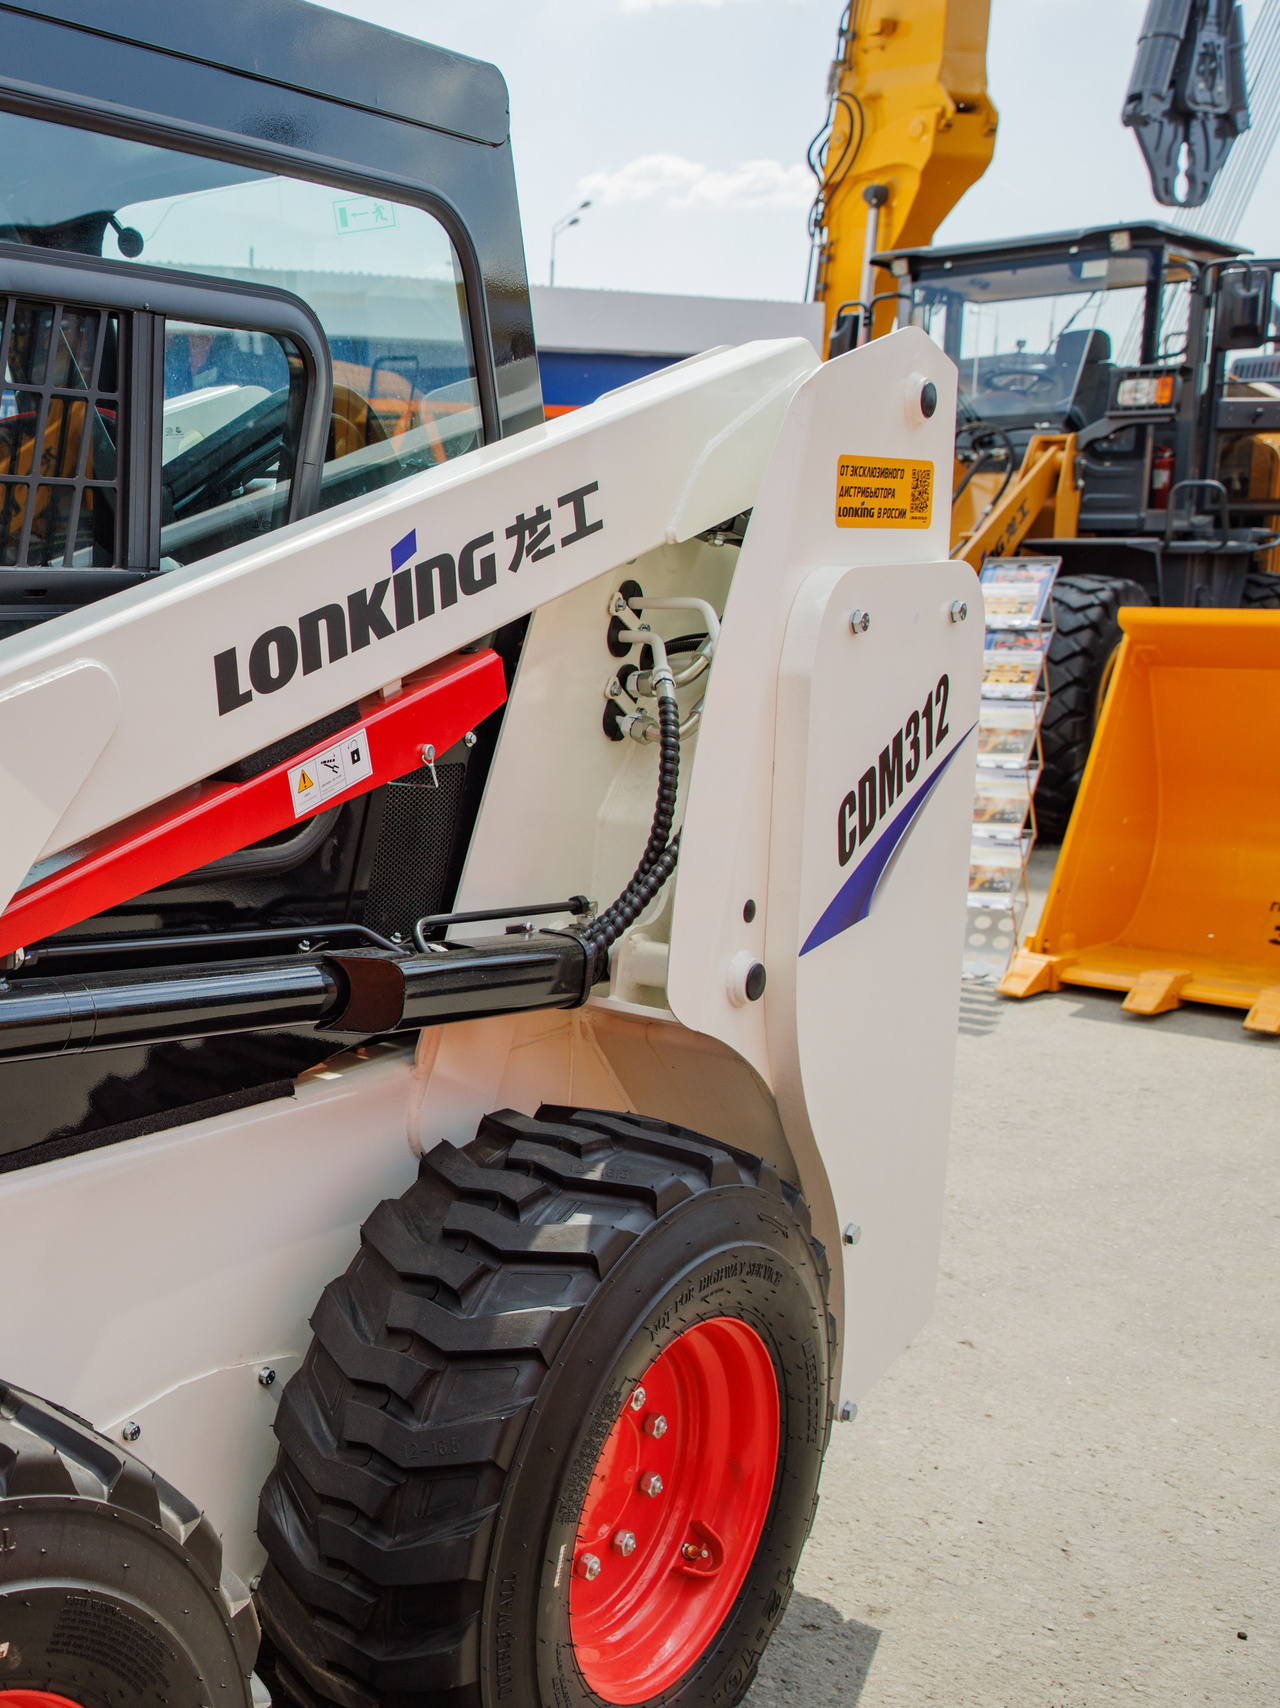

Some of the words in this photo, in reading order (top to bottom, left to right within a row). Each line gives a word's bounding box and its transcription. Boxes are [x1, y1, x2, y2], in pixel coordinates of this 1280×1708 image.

[839, 486, 896, 499] ДИСТРИБЬЮТОРА
[840, 465, 849, 477] ОТ
[850, 465, 905, 479] ЭКСКЛЮЗИВНОГО
[838, 501, 875, 518] LONKING
[877, 507, 882, 518] В
[882, 508, 907, 519] РОССИИ
[213, 528, 497, 717] LONKING
[504, 480, 604, 573] 龙工
[837, 673, 949, 867] CDM312
[647, 1306, 672, 1342] NOT
[674, 1285, 695, 1314] FOR
[698, 1261, 747, 1293] HIGHWAY
[747, 1261, 783, 1287] SERVICE
[402, 1437, 460, 1460] 12-16.5
[496, 1571, 518, 1628] WALL
[496, 1630, 513, 1701] DOUBLE
